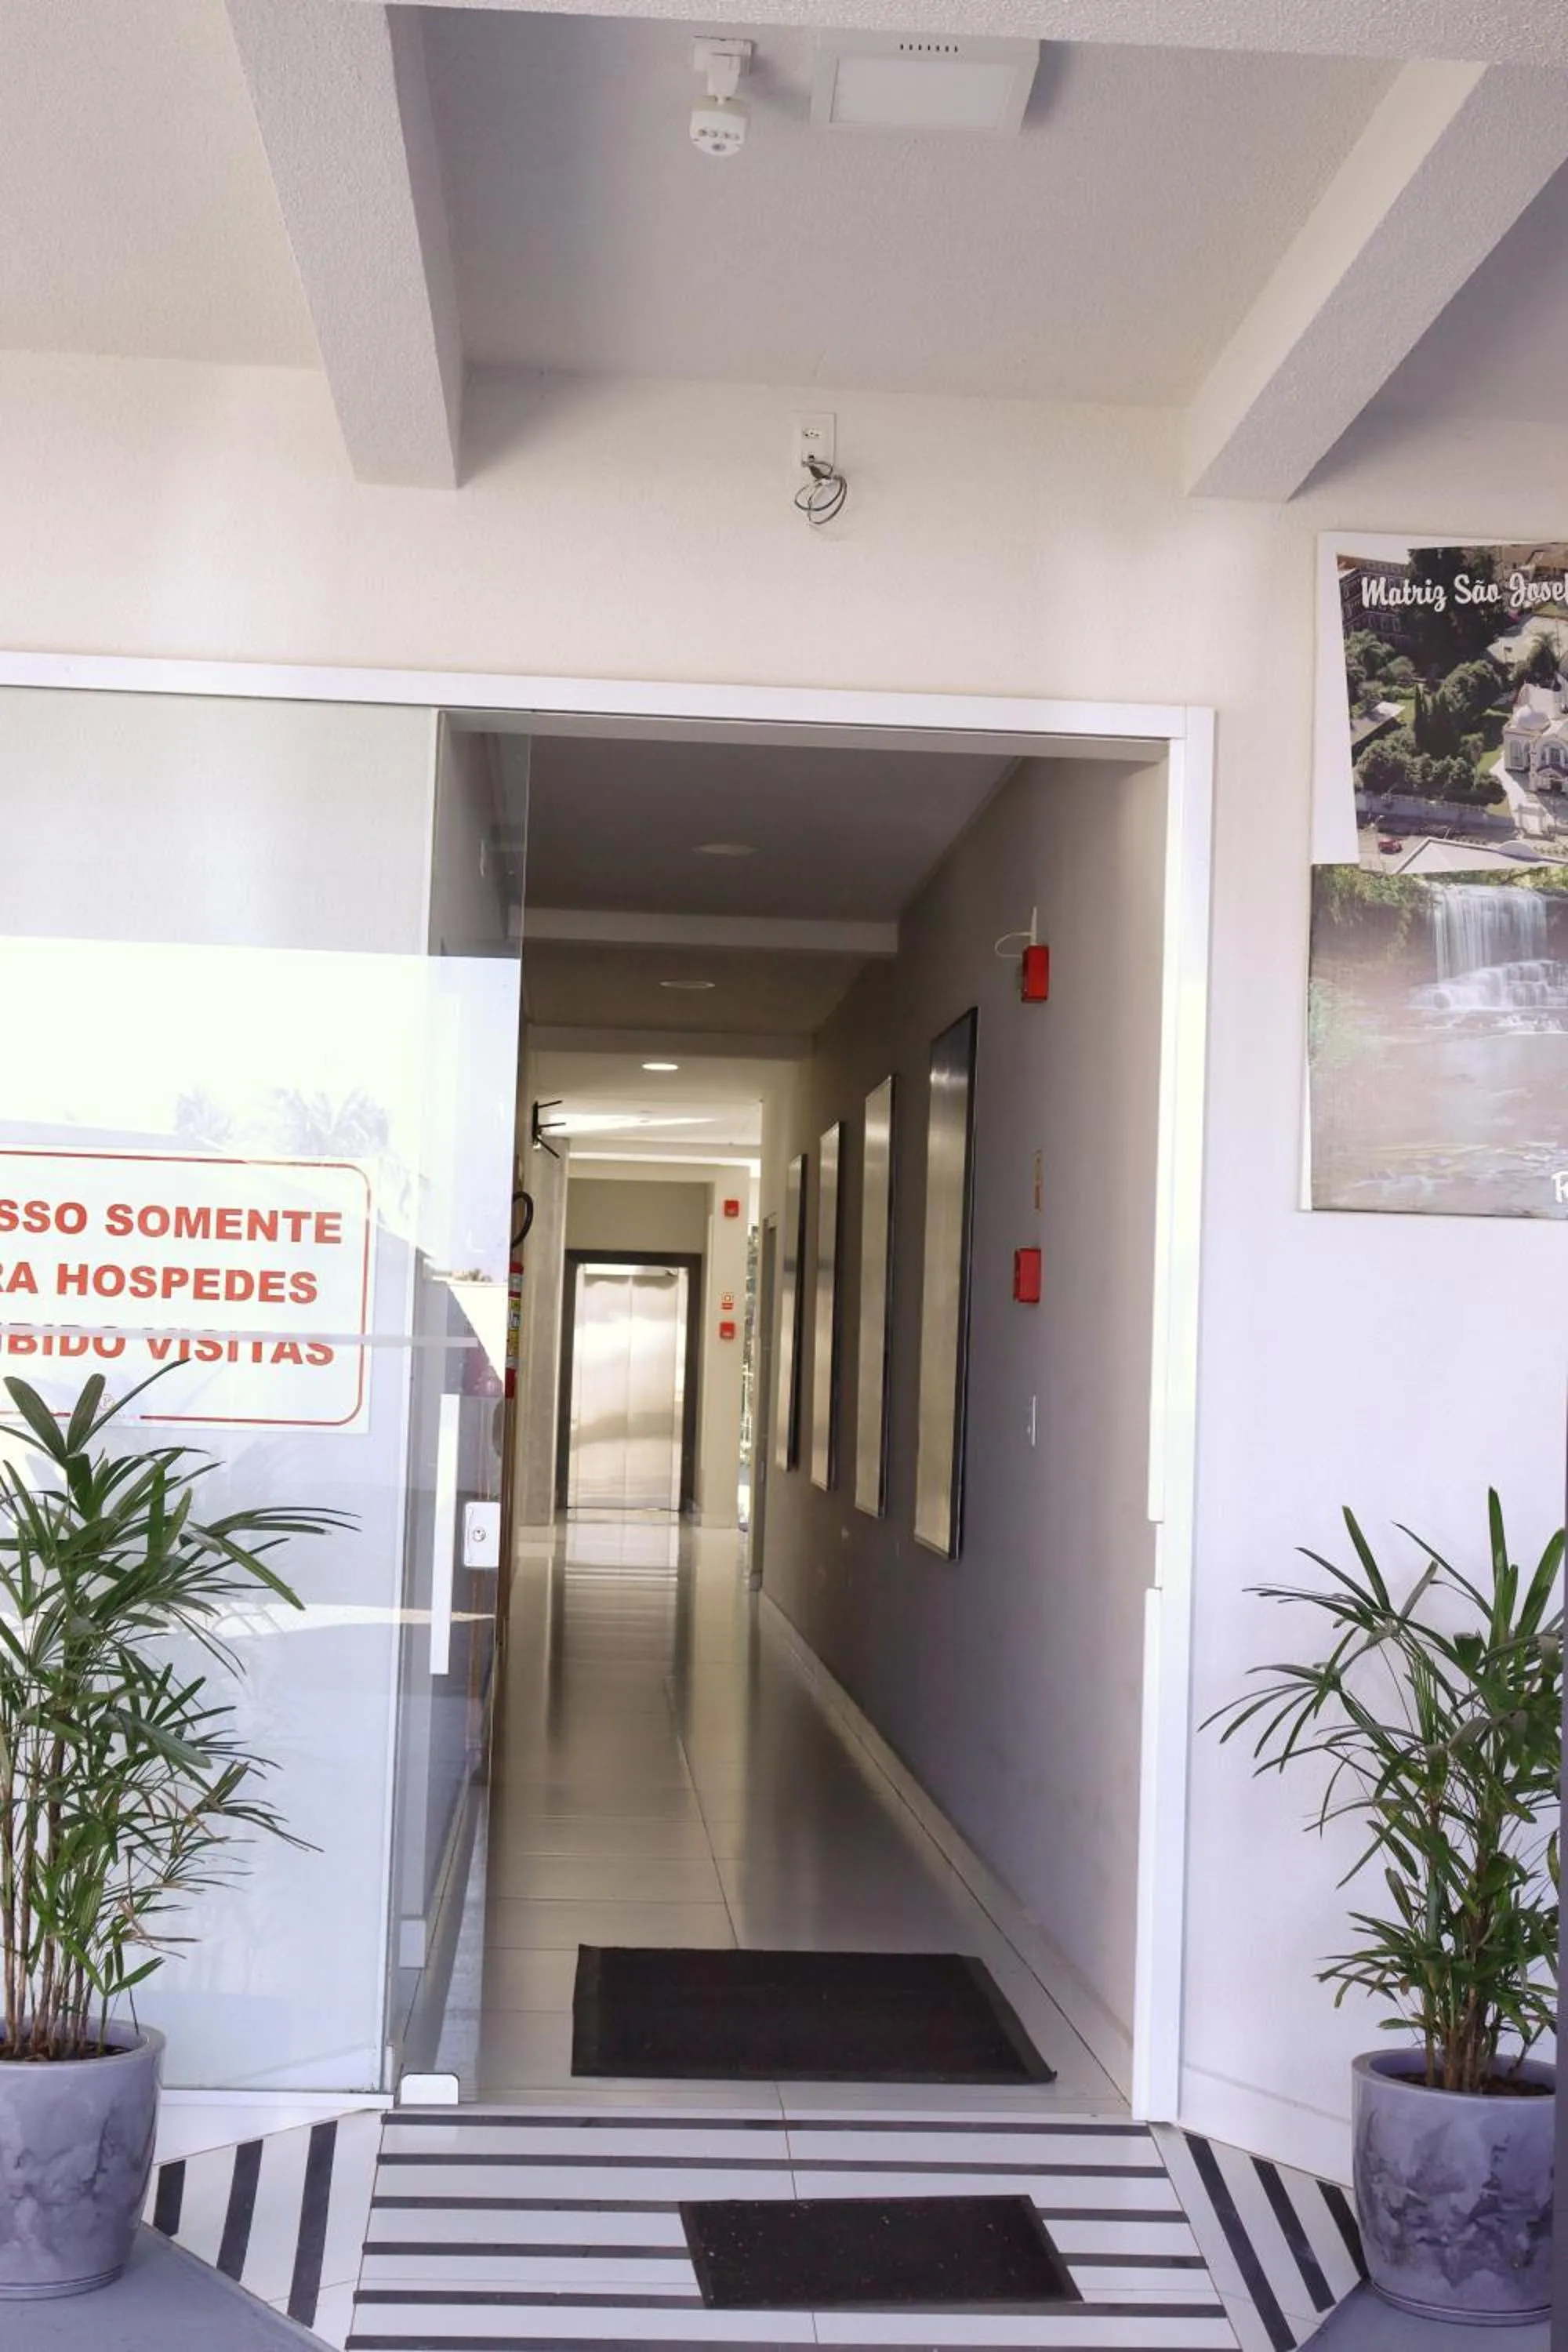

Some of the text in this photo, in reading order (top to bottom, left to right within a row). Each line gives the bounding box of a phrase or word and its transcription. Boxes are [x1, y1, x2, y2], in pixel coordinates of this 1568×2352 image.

[1360, 575, 1447, 612] Matriz
[1454, 573, 1501, 604] São
[105, 1203, 343, 1243] SOMENTE
[0, 1262, 318, 1304] A HOSPEDES
[0, 1323, 126, 1358] BIDO
